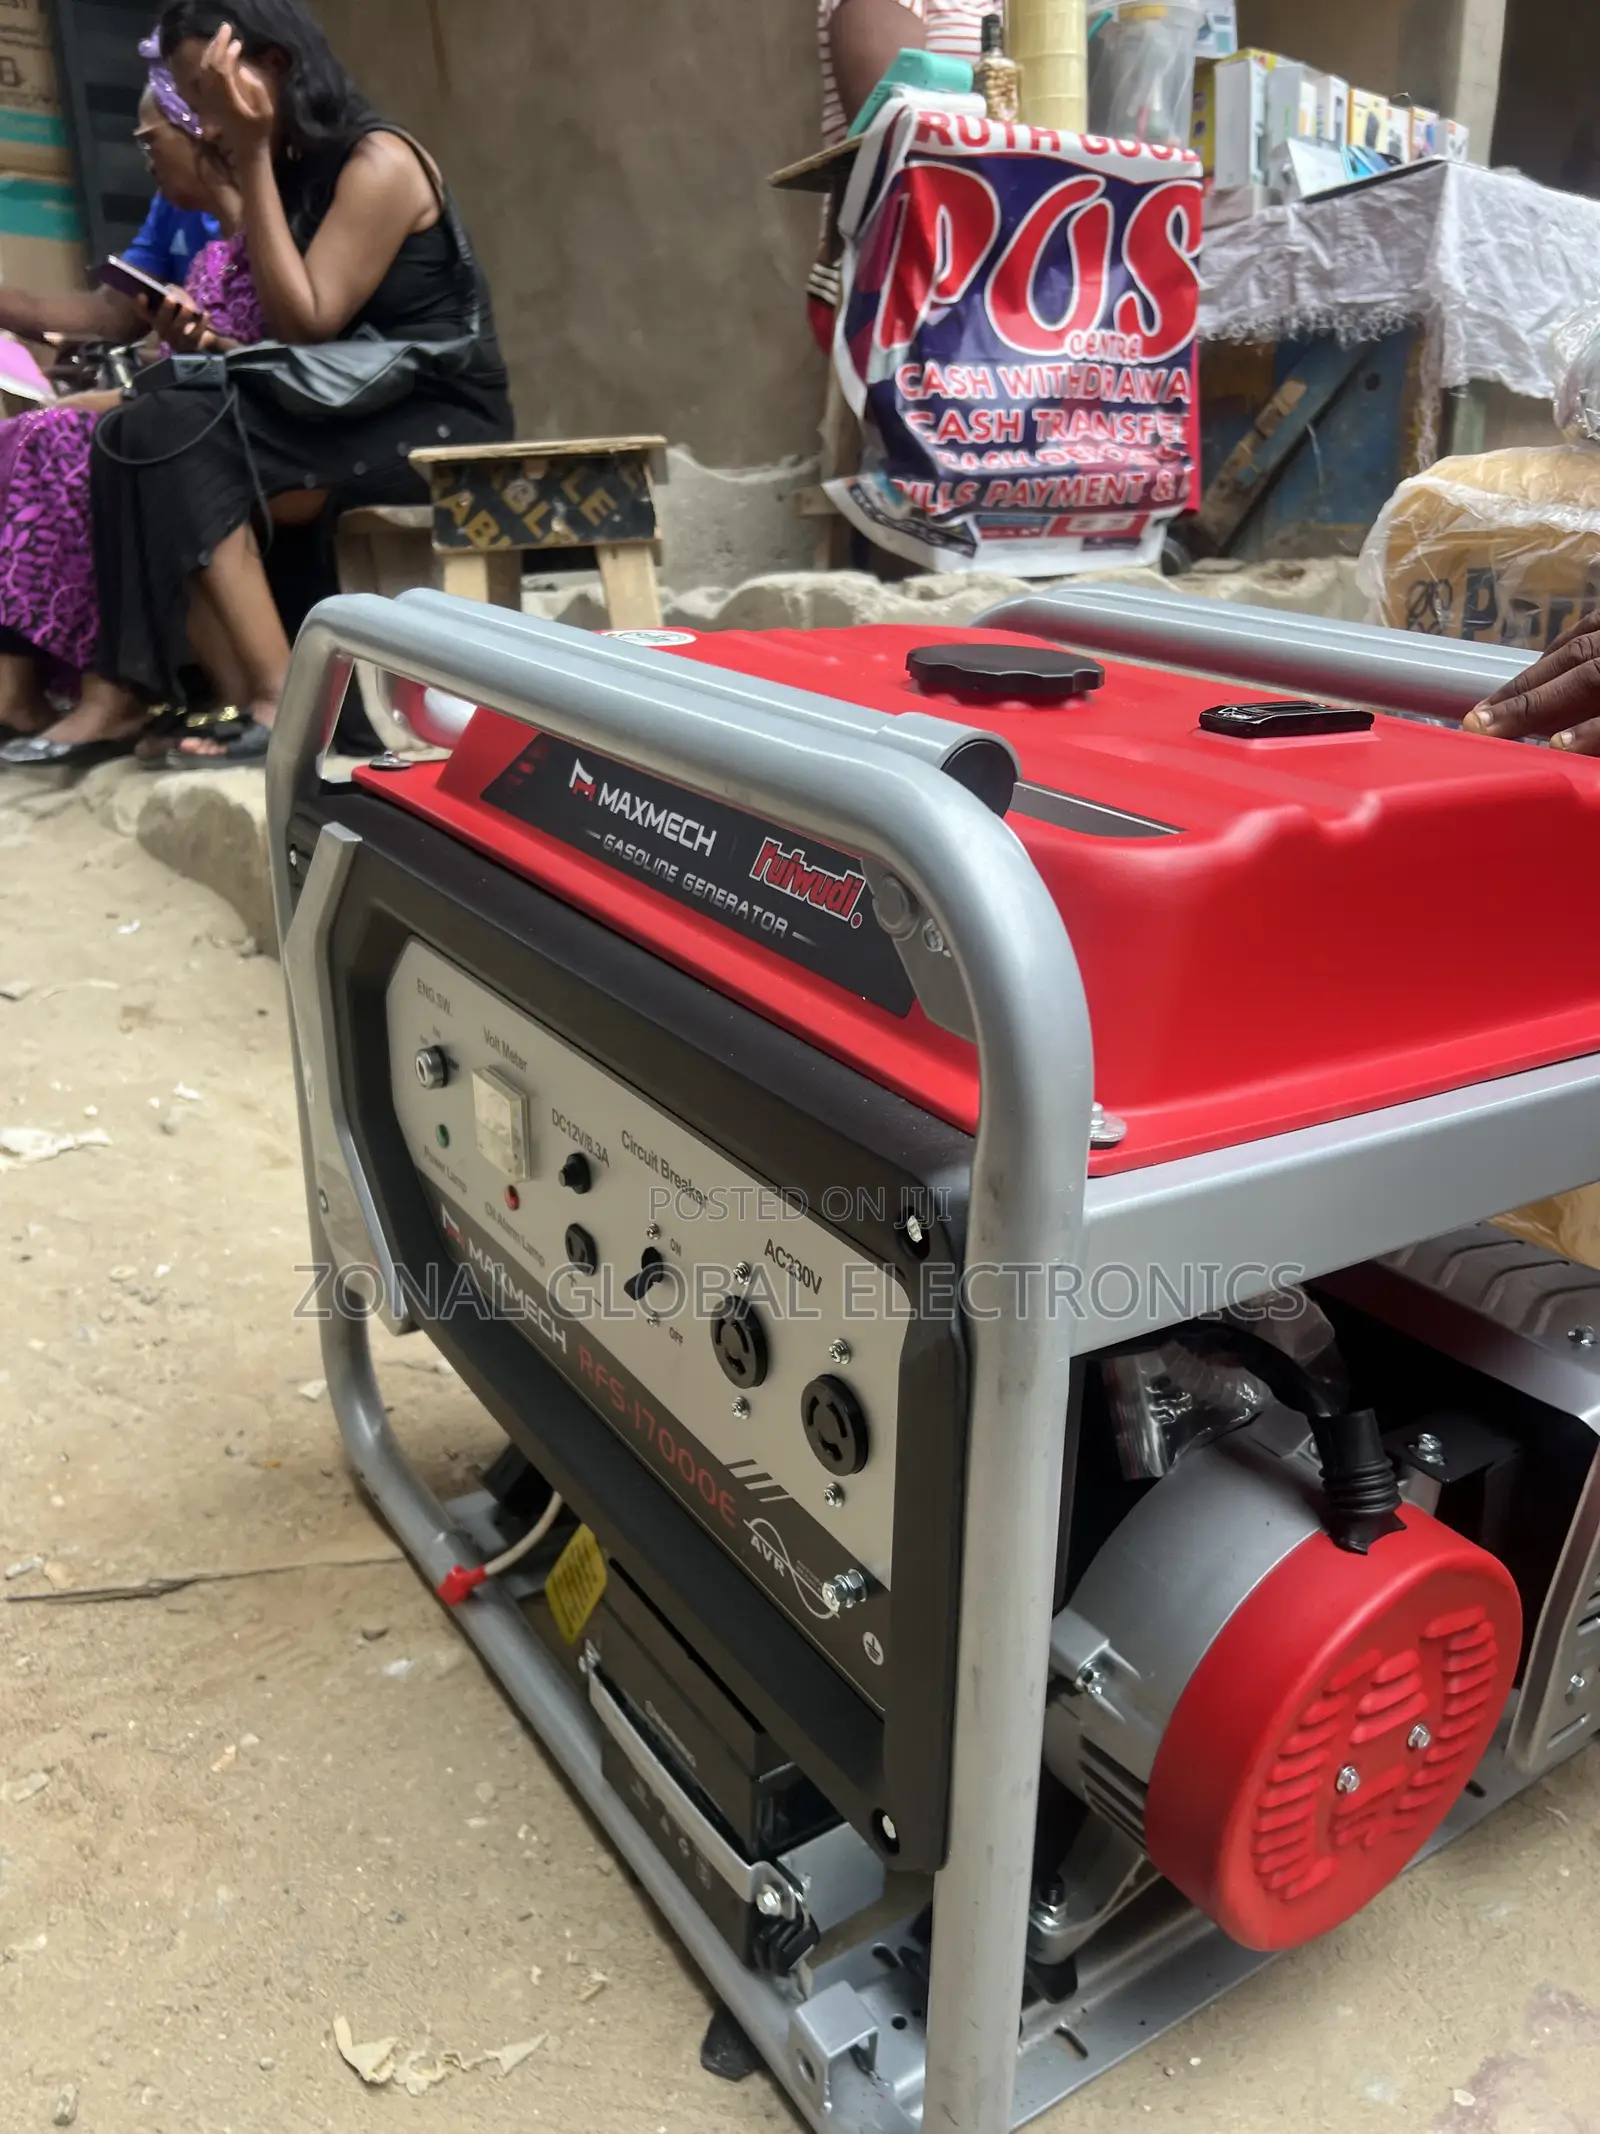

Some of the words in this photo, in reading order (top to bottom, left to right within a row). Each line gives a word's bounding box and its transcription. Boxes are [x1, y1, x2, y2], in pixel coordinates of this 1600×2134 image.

[880, 161, 1202, 362] POS
[898, 362, 996, 399] CASH
[906, 409, 1024, 444] CASH
[982, 472, 1148, 508] PAYMENT
[597, 782, 718, 857] MAXMECH
[602, 833, 679, 884] GASOLINE
[682, 872, 789, 940] GENERATOR
[483, 1025, 501, 1054] Volt
[502, 1040, 528, 1073] Meter
[621, 1130, 659, 1173] Circuit
[661, 1158, 709, 1210] Breaker
[763, 1238, 823, 1295] AC230V
[468, 1237, 567, 1355] MAXMECH
[750, 1534, 785, 1578] AVR
